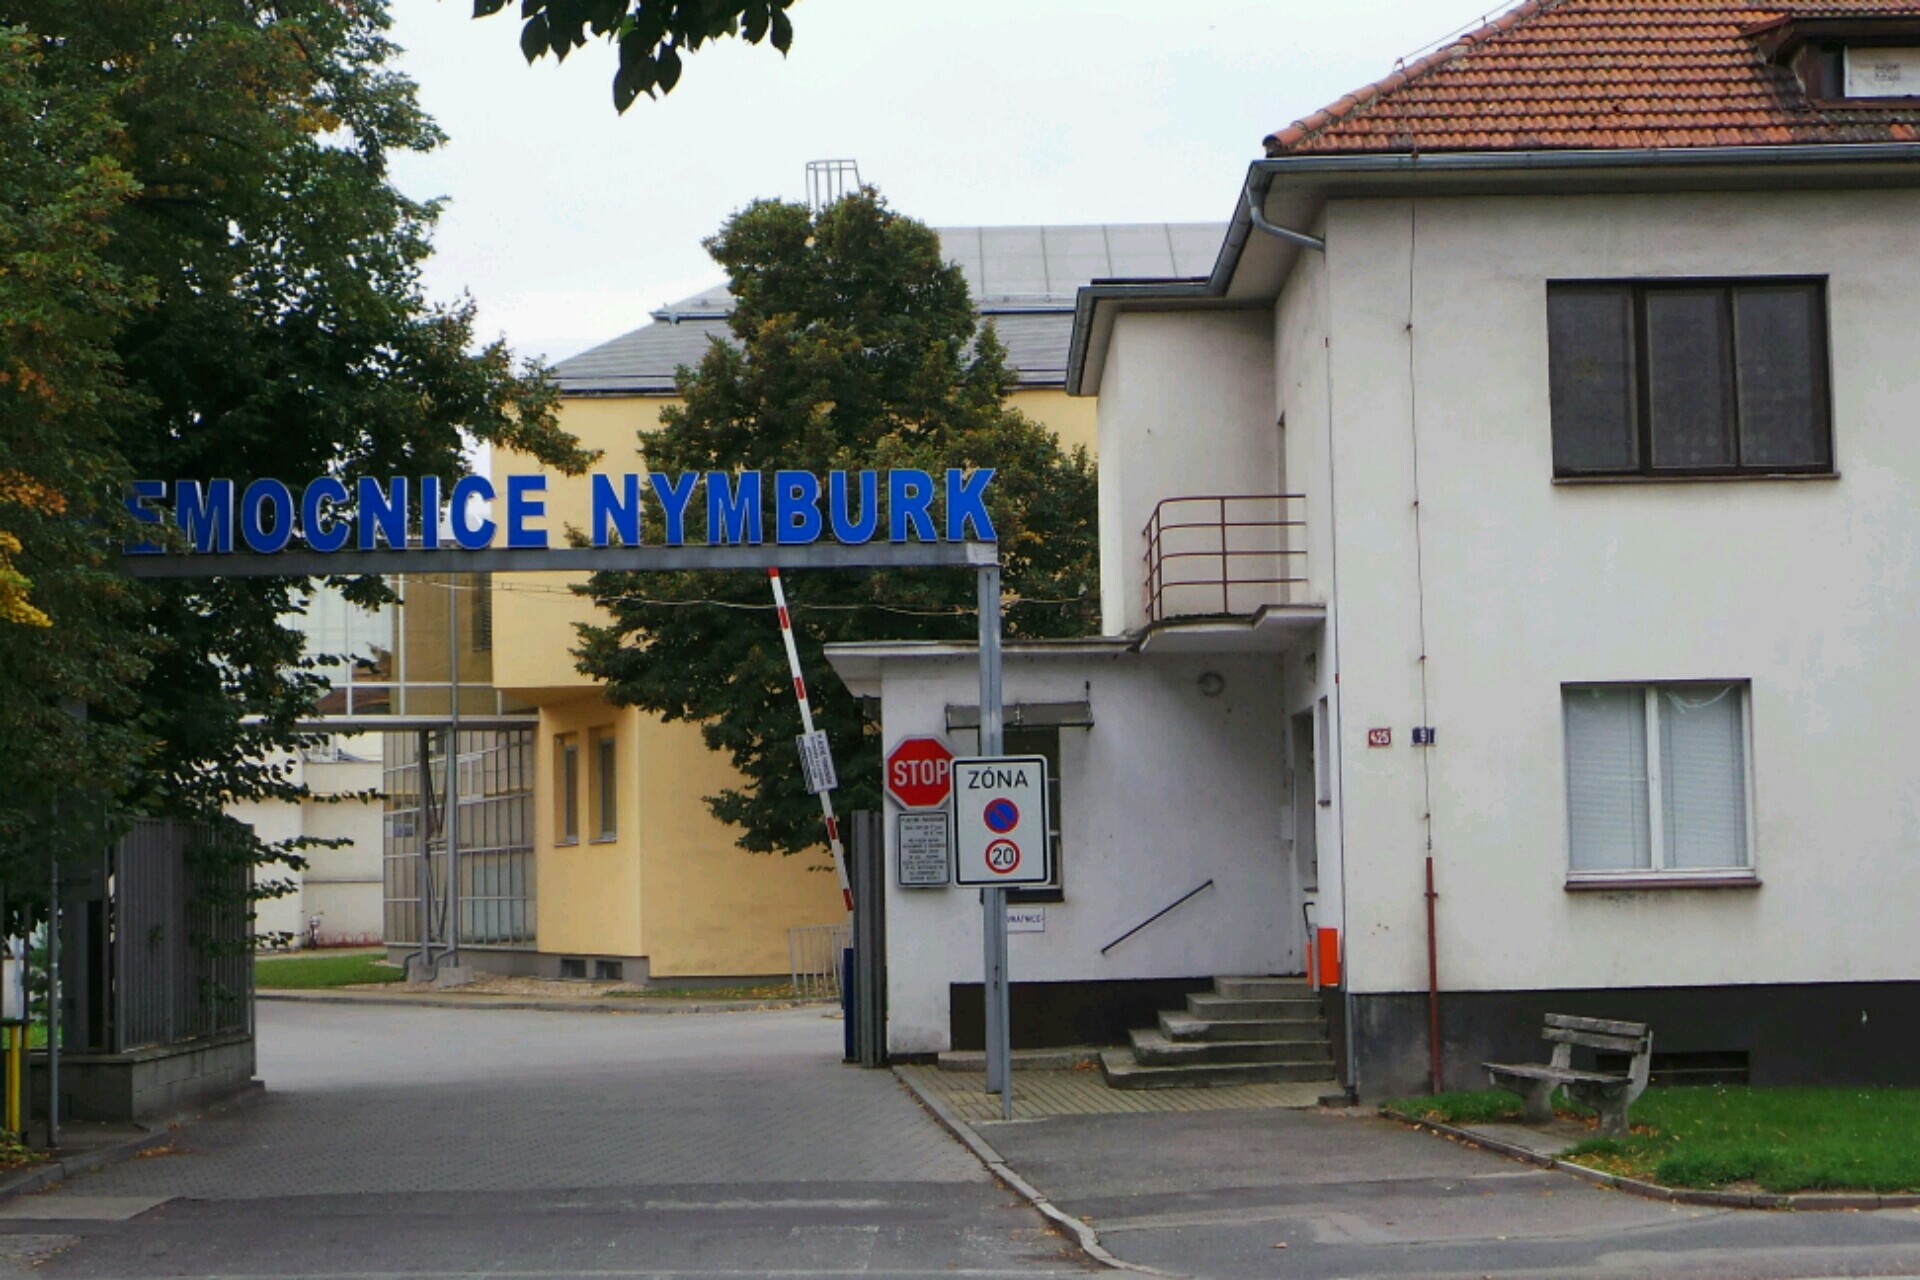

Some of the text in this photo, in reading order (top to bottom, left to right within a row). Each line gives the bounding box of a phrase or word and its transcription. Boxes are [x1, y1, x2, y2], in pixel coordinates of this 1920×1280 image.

[112, 468, 998, 555] EMOCNICE NYMBURK
[893, 759, 949, 787] STOP
[968, 766, 1029, 789] ZÓNA
[992, 847, 1015, 866] 20
